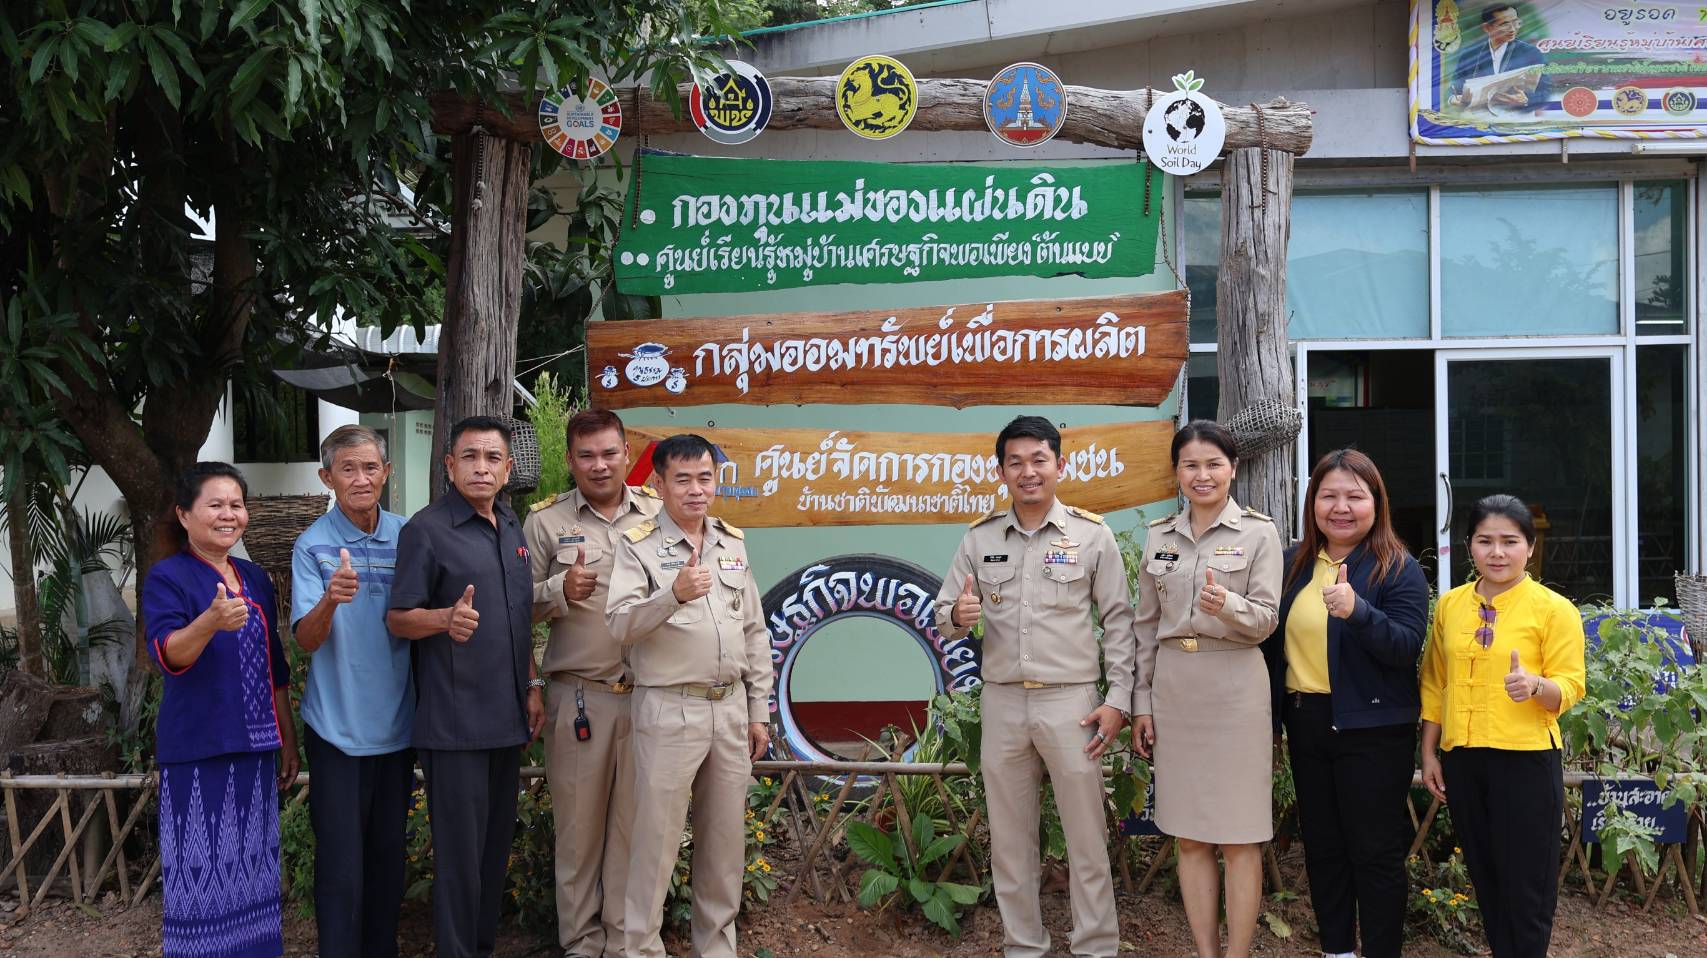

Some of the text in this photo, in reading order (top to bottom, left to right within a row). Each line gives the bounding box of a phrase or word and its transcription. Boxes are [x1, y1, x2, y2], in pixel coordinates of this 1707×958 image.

[1604, 7, 1676, 25] อยูรอด
[566, 120, 595, 128] GOALS
[1167, 144, 1197, 155] World
[1161, 156, 1202, 171] Soil Day
[672, 173, 1088, 240] กองทุนแม่ของแผ่นดิน
[655, 230, 1031, 289] ศูนย์เรียนรู้หมู่บ้านเศรษฐกิจพอเพียง
[693, 304, 1146, 397] กลุ่มออมทรัพย์เพื่อการผลิต
[797, 483, 996, 514] บ้านชาติพัฒนาชาติไทย
